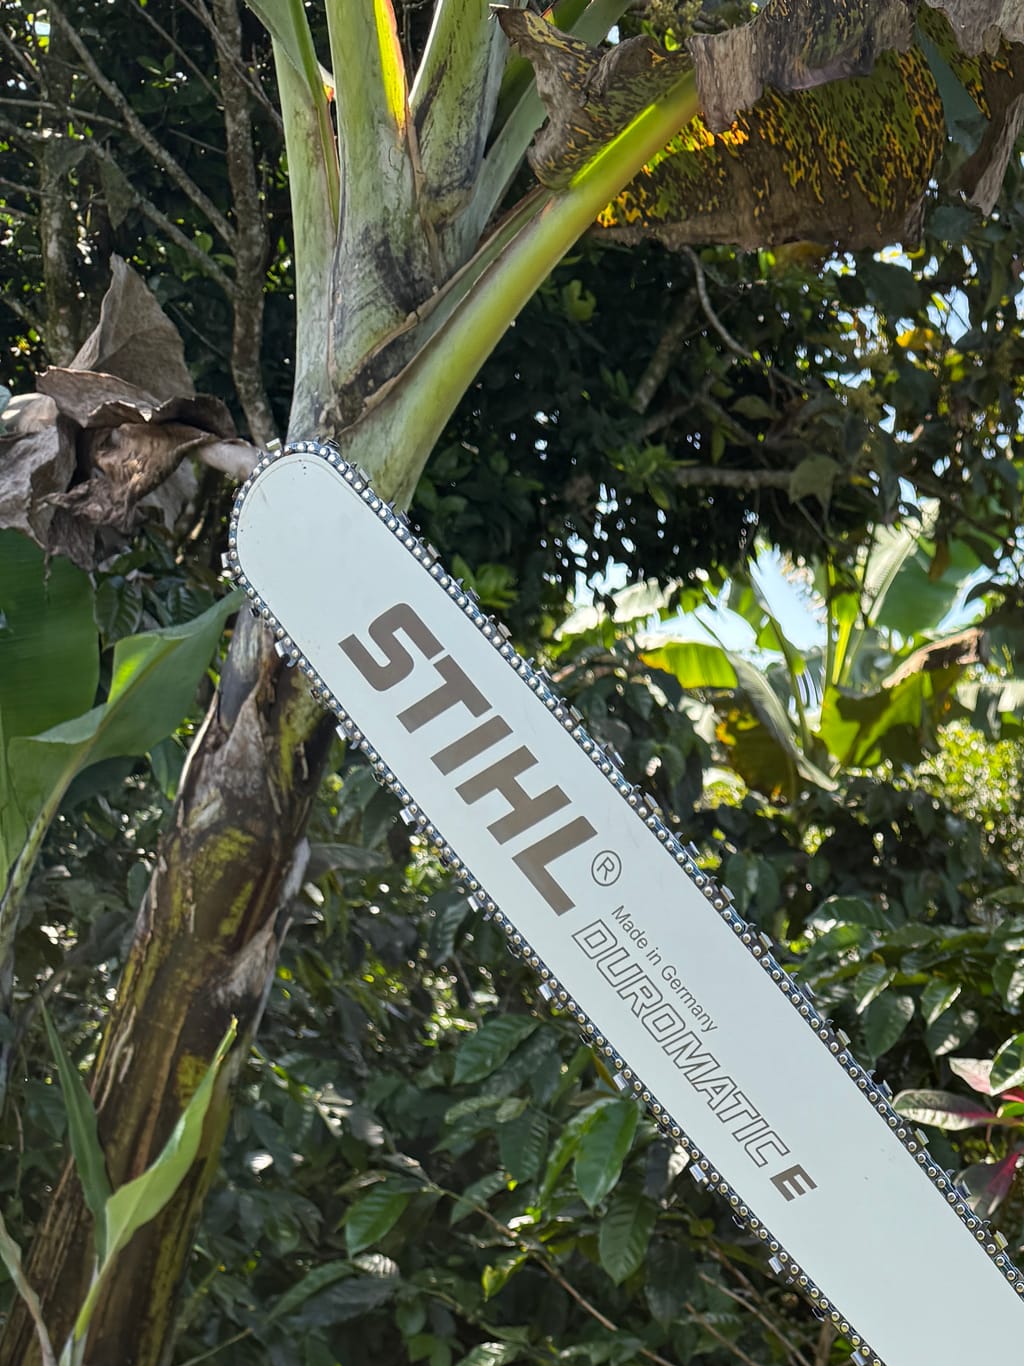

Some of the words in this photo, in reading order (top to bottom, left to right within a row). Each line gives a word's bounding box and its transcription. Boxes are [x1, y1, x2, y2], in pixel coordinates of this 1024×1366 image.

[338, 602, 598, 917] STIHL
[571, 918, 790, 1167] DUROMATIC
[771, 1163, 817, 1202] E
[611, 904, 648, 949] Made
[646, 947, 662, 966] in
[661, 965, 719, 1033] Germany
